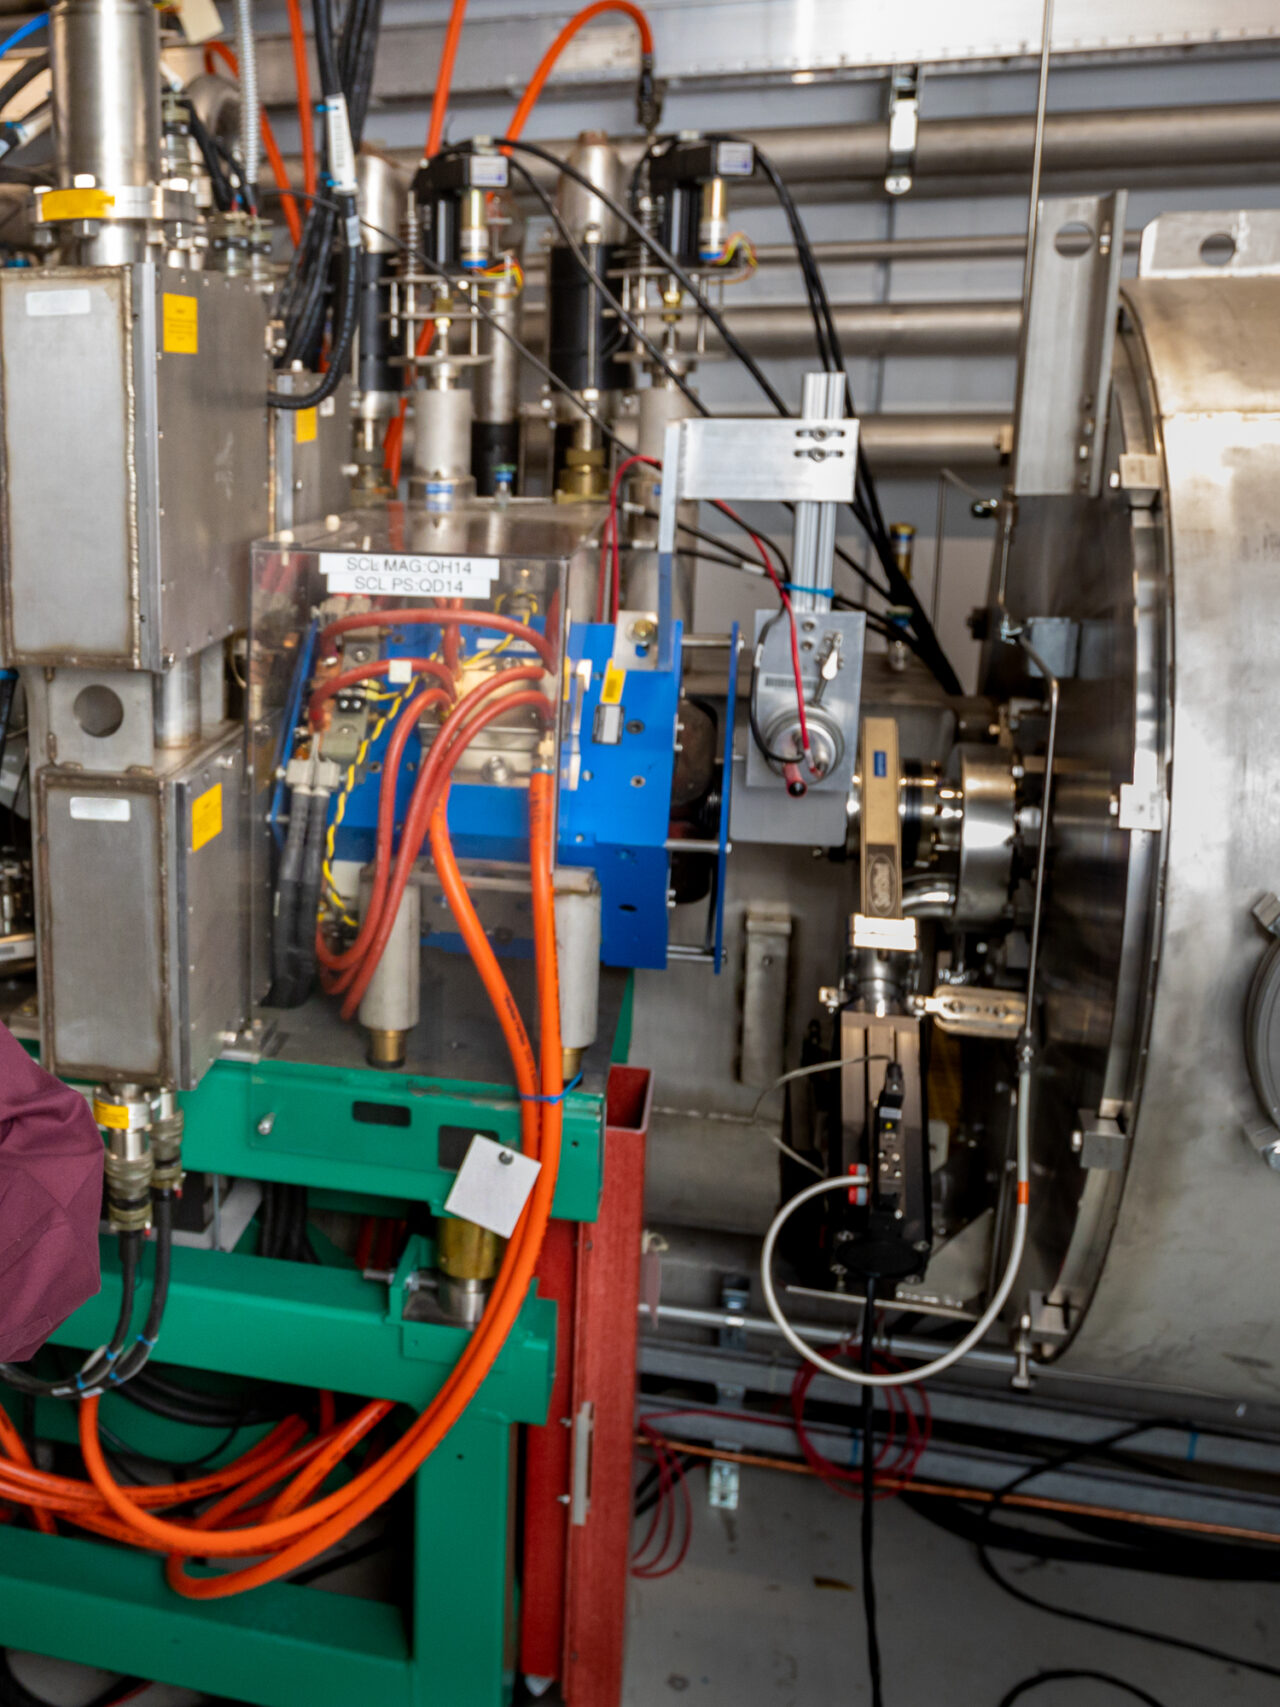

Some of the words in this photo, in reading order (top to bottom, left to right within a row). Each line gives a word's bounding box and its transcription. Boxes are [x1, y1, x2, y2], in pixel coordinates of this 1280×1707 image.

[346, 556, 379, 572] SCL
[384, 558, 472, 575] MAG:QH14
[354, 575, 388, 591] SCL
[392, 577, 464, 594] PS:QD14
